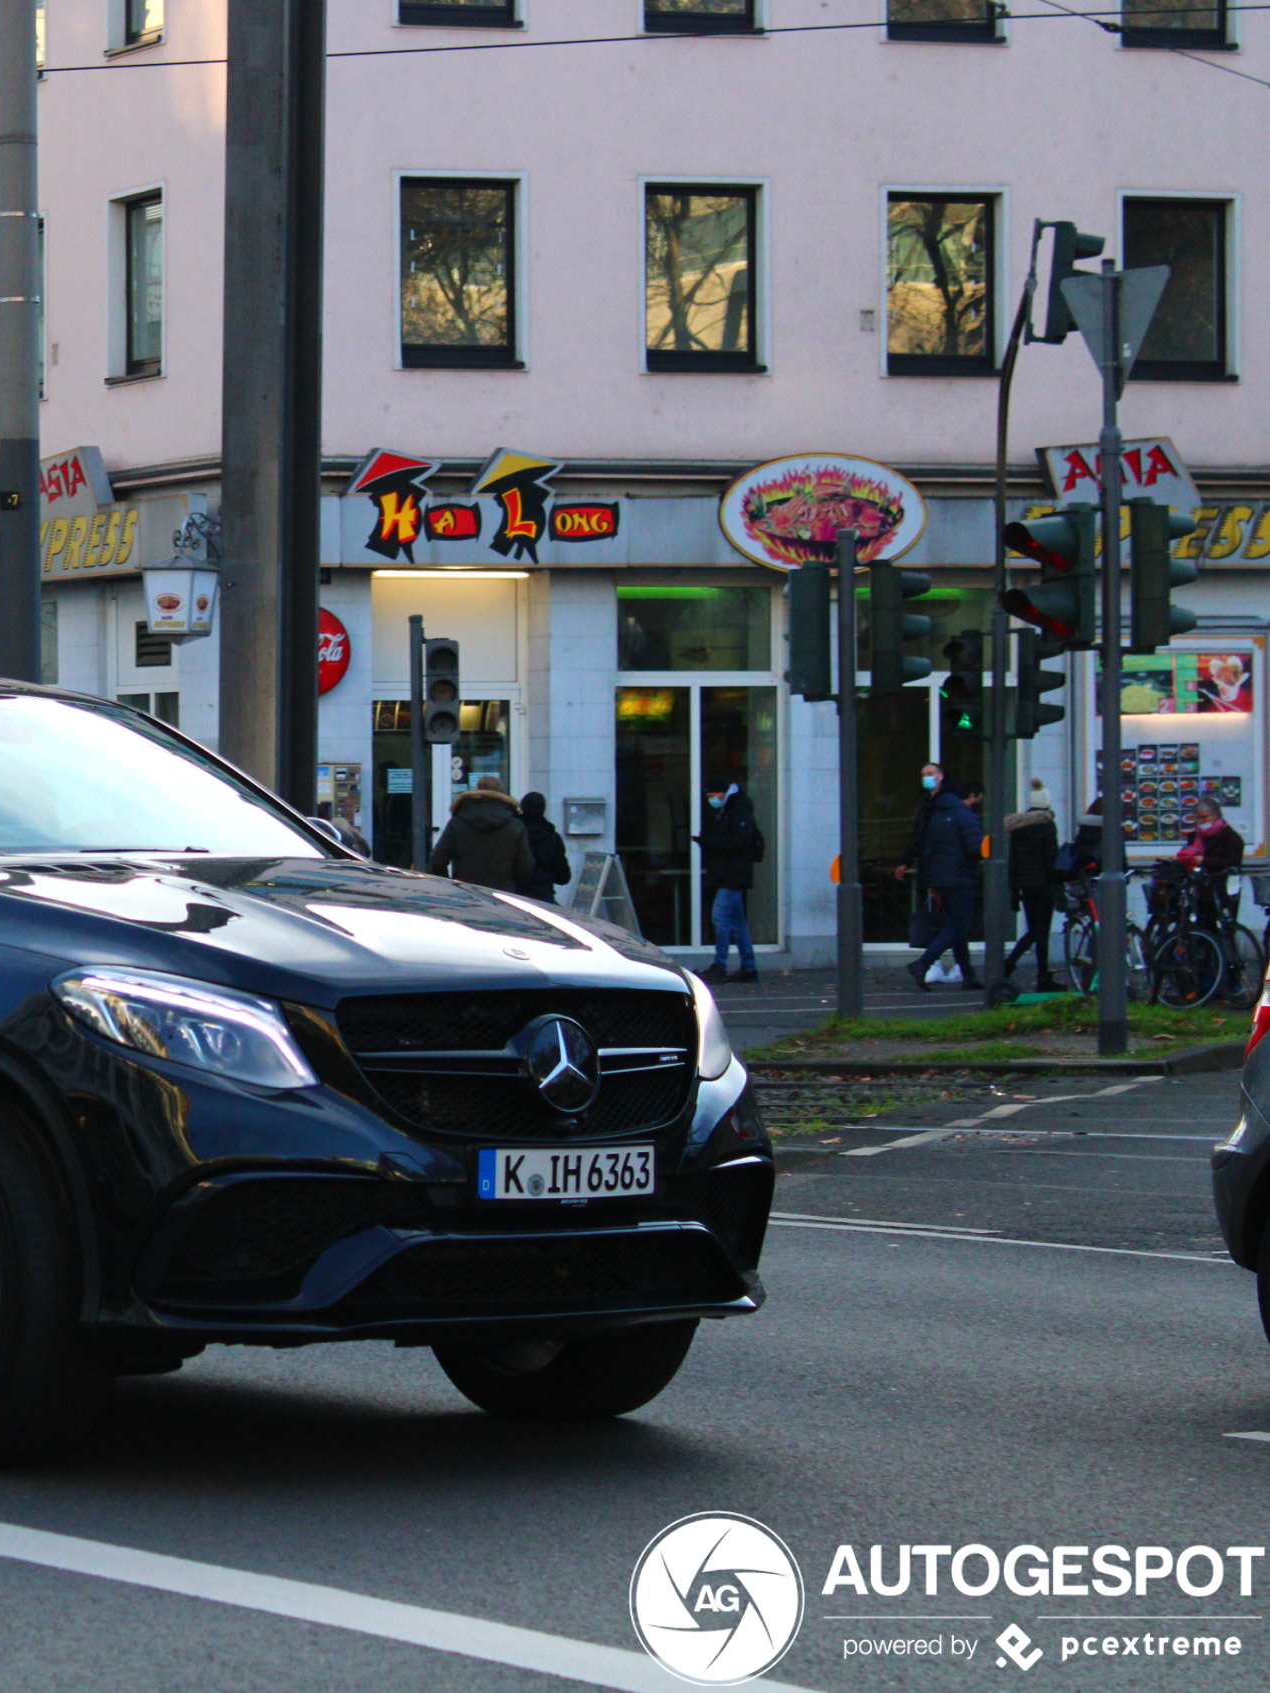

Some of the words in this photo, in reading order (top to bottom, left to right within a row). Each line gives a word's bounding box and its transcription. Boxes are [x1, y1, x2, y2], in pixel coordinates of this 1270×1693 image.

[40, 509, 139, 572] PRESS
[482, 1179, 491, 1191] D
[504, 1155, 526, 1193] K
[547, 1154, 583, 1193] IH
[587, 1151, 650, 1192] 6363
